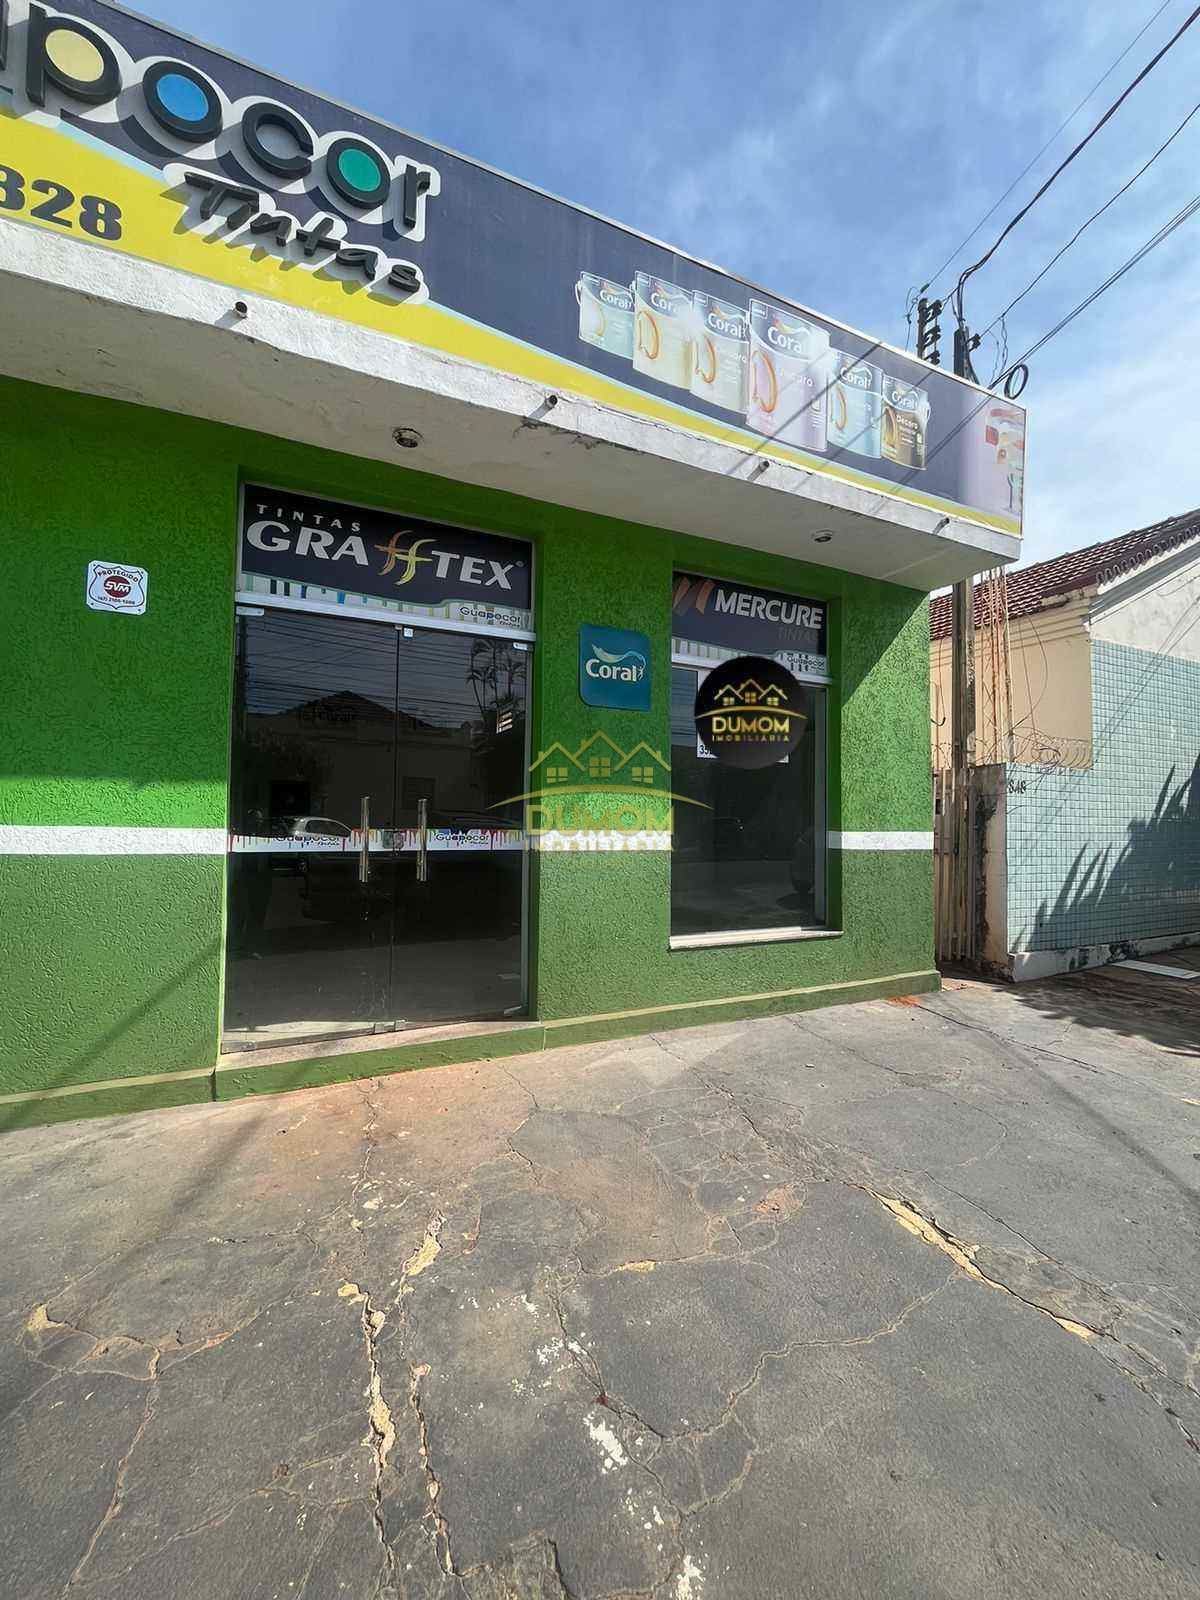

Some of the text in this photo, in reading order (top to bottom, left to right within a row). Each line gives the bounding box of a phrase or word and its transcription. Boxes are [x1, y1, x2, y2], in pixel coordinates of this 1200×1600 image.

[184, 171, 421, 294] Tintas
[600, 289, 630, 309] Coral
[708, 312, 742, 338] Coral
[841, 367, 869, 390] Coral
[257, 503, 360, 532] TINTAS
[459, 606, 520, 623] Guapocor
[714, 588, 823, 629] MERCURE
[585, 658, 637, 682] Coral
